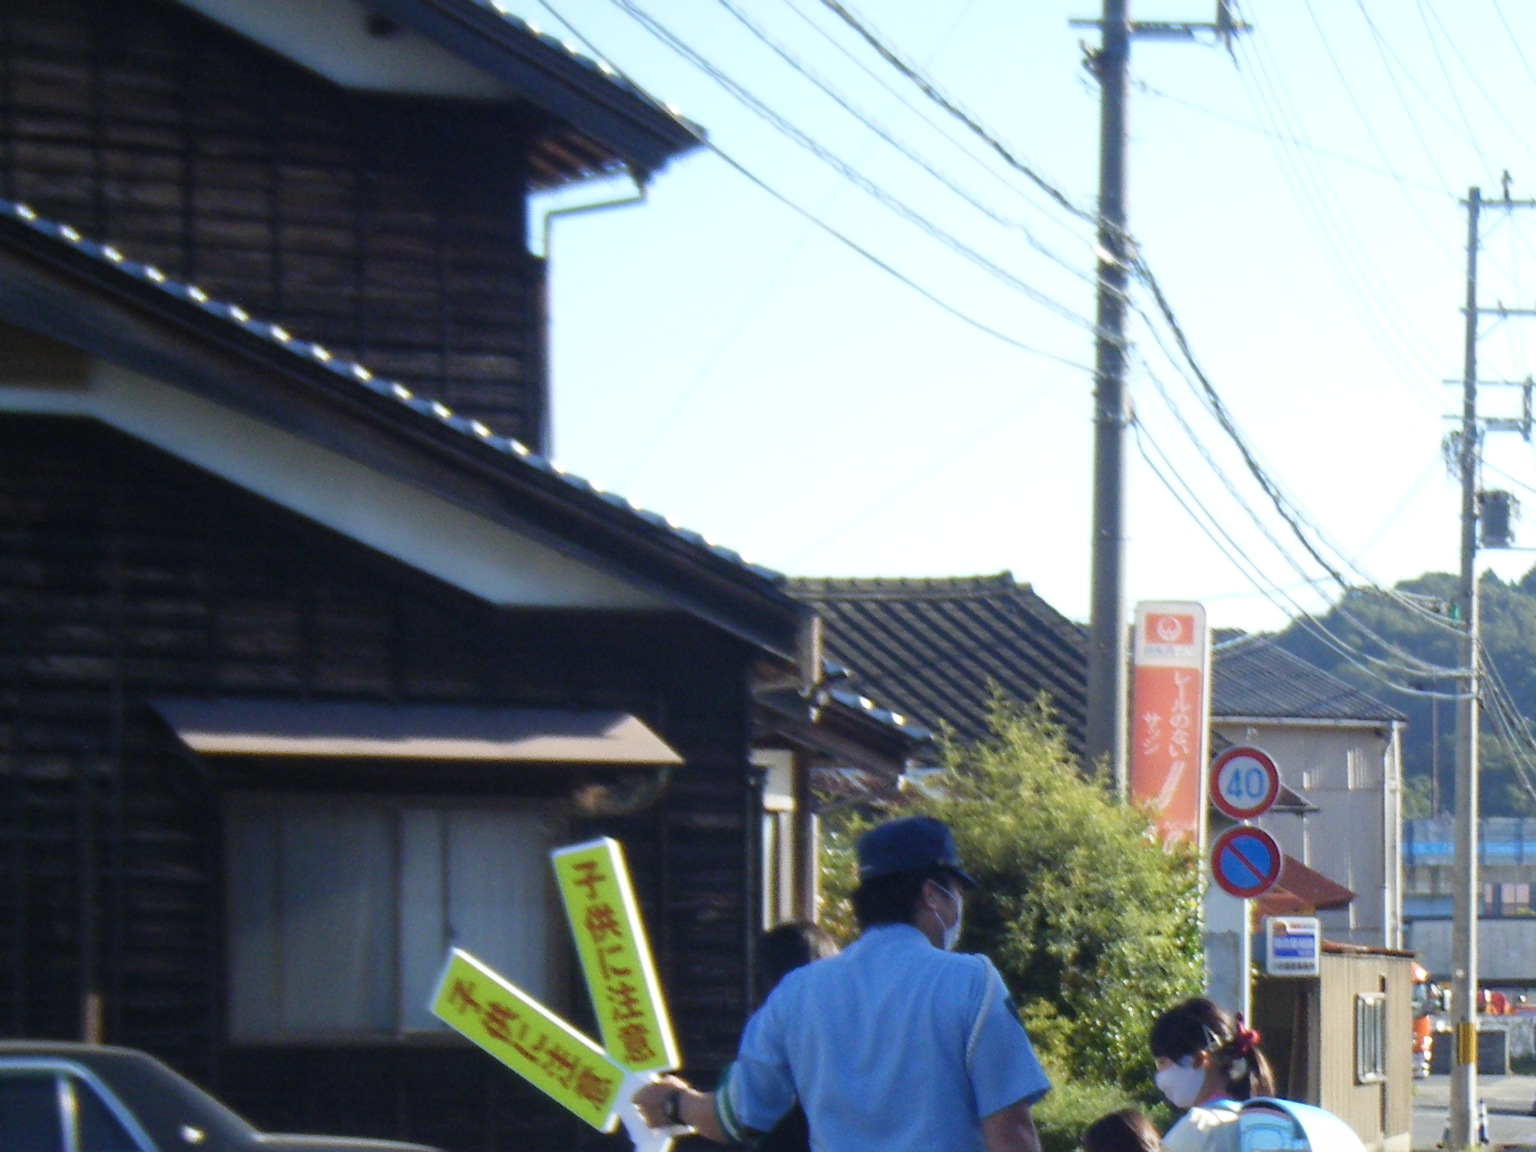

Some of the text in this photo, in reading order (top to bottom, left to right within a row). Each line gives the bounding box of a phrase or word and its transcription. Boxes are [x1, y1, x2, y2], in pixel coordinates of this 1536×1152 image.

[1142, 711, 1162, 756] サッシ
[1168, 671, 1193, 758] レールのない
[1226, 767, 1265, 799] 40
